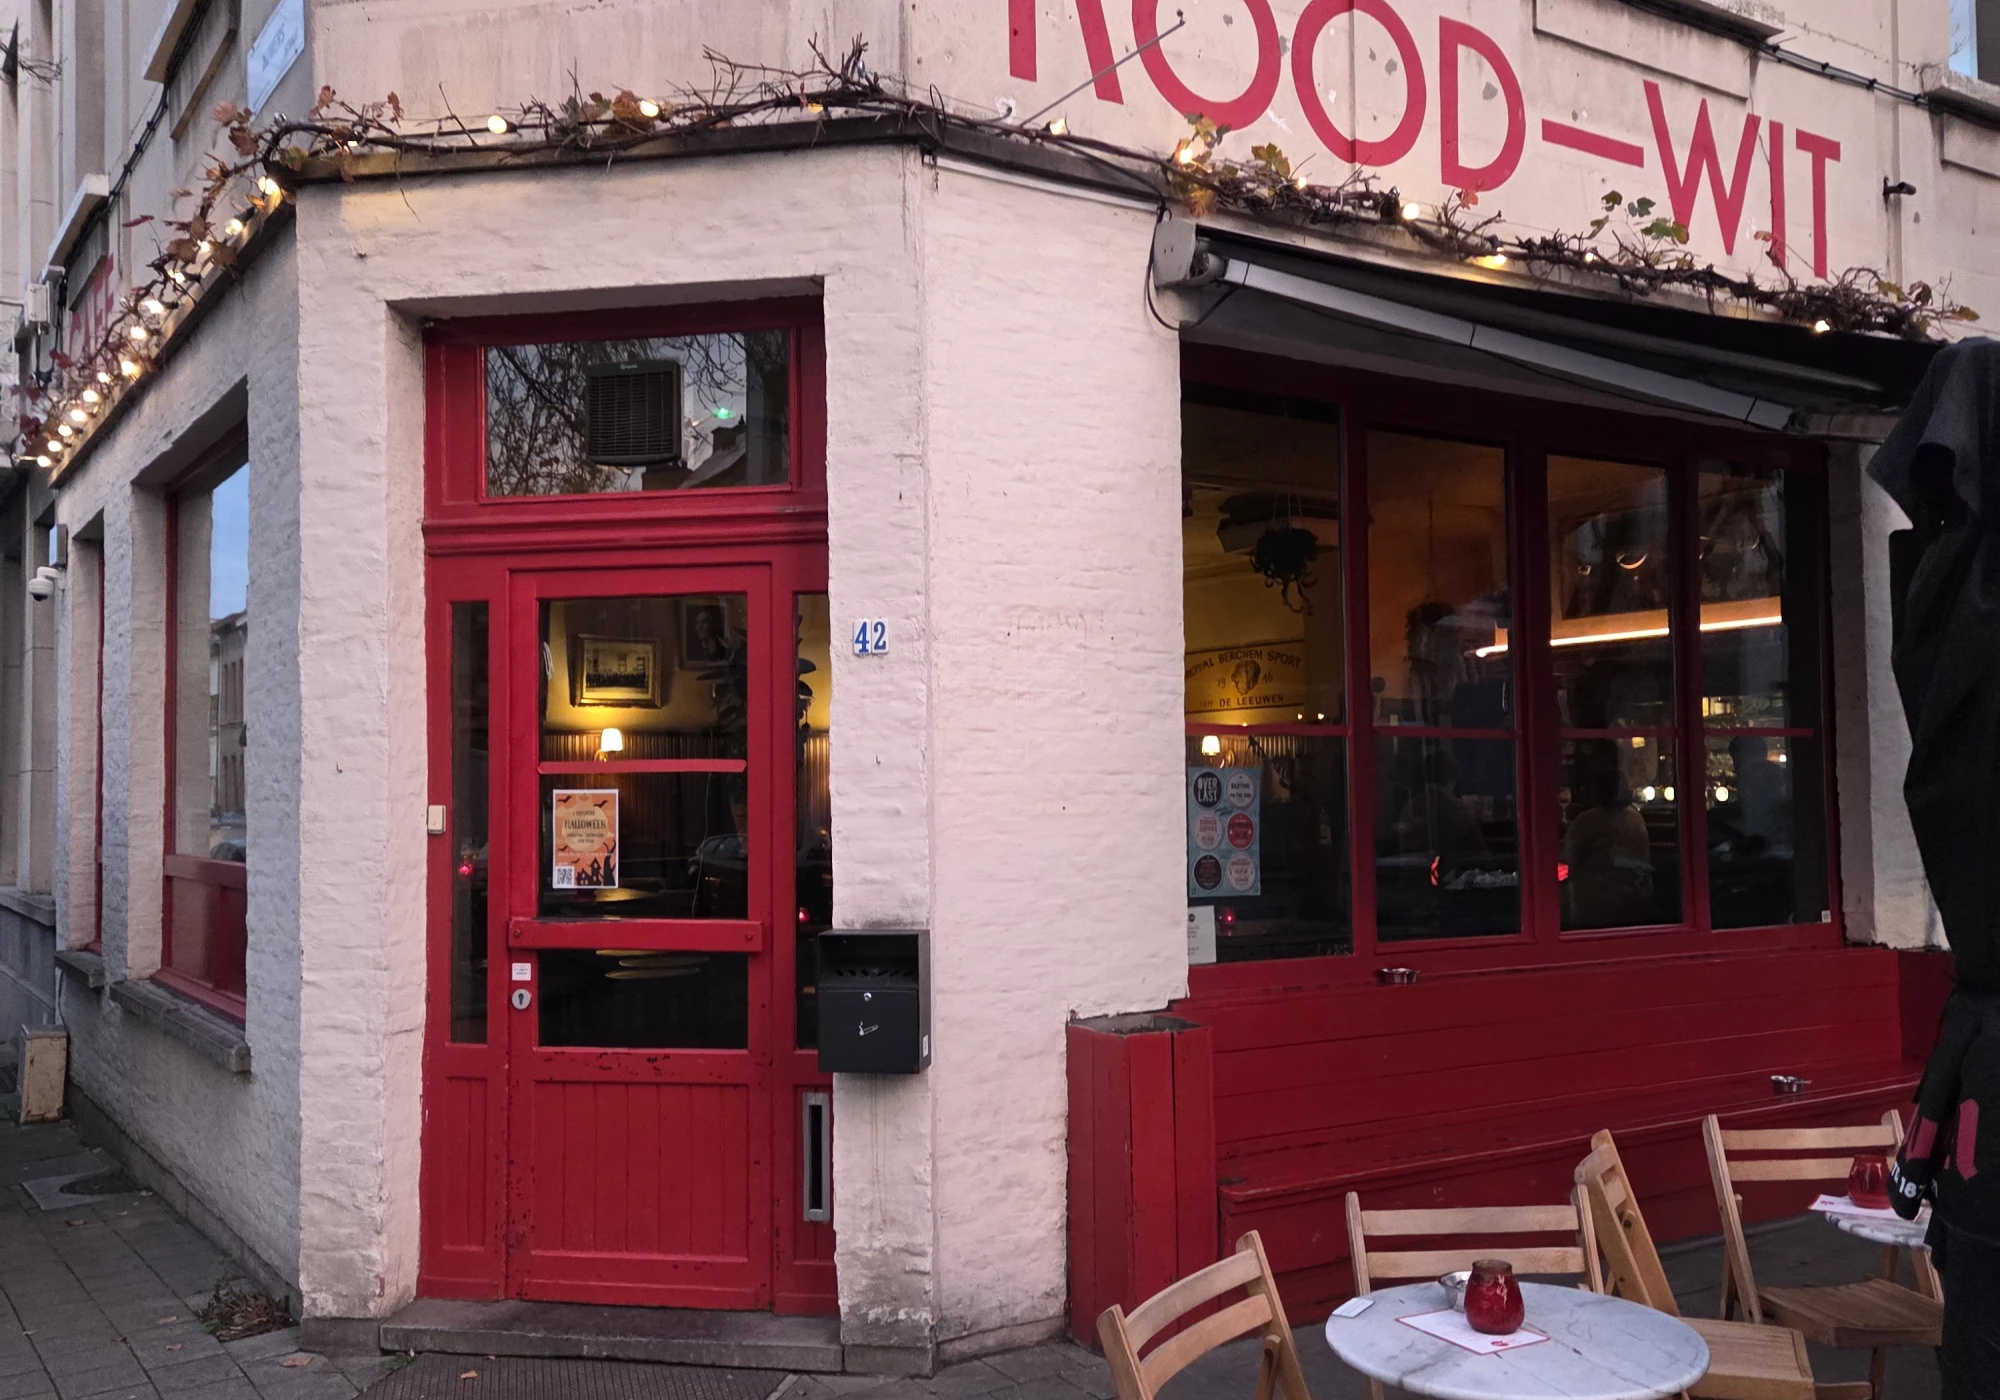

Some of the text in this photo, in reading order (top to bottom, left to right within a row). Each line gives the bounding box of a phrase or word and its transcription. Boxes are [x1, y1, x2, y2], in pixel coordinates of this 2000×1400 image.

[855, 621, 887, 653] 42
[1218, 649, 1263, 664] BERCHEM
[1267, 651, 1302, 669] SPORT
[1219, 698, 1231, 707] DE
[1237, 694, 1284, 706] LEEUWEN
[1197, 777, 1218, 790] OVER
[1197, 789, 1218, 802] LAST
